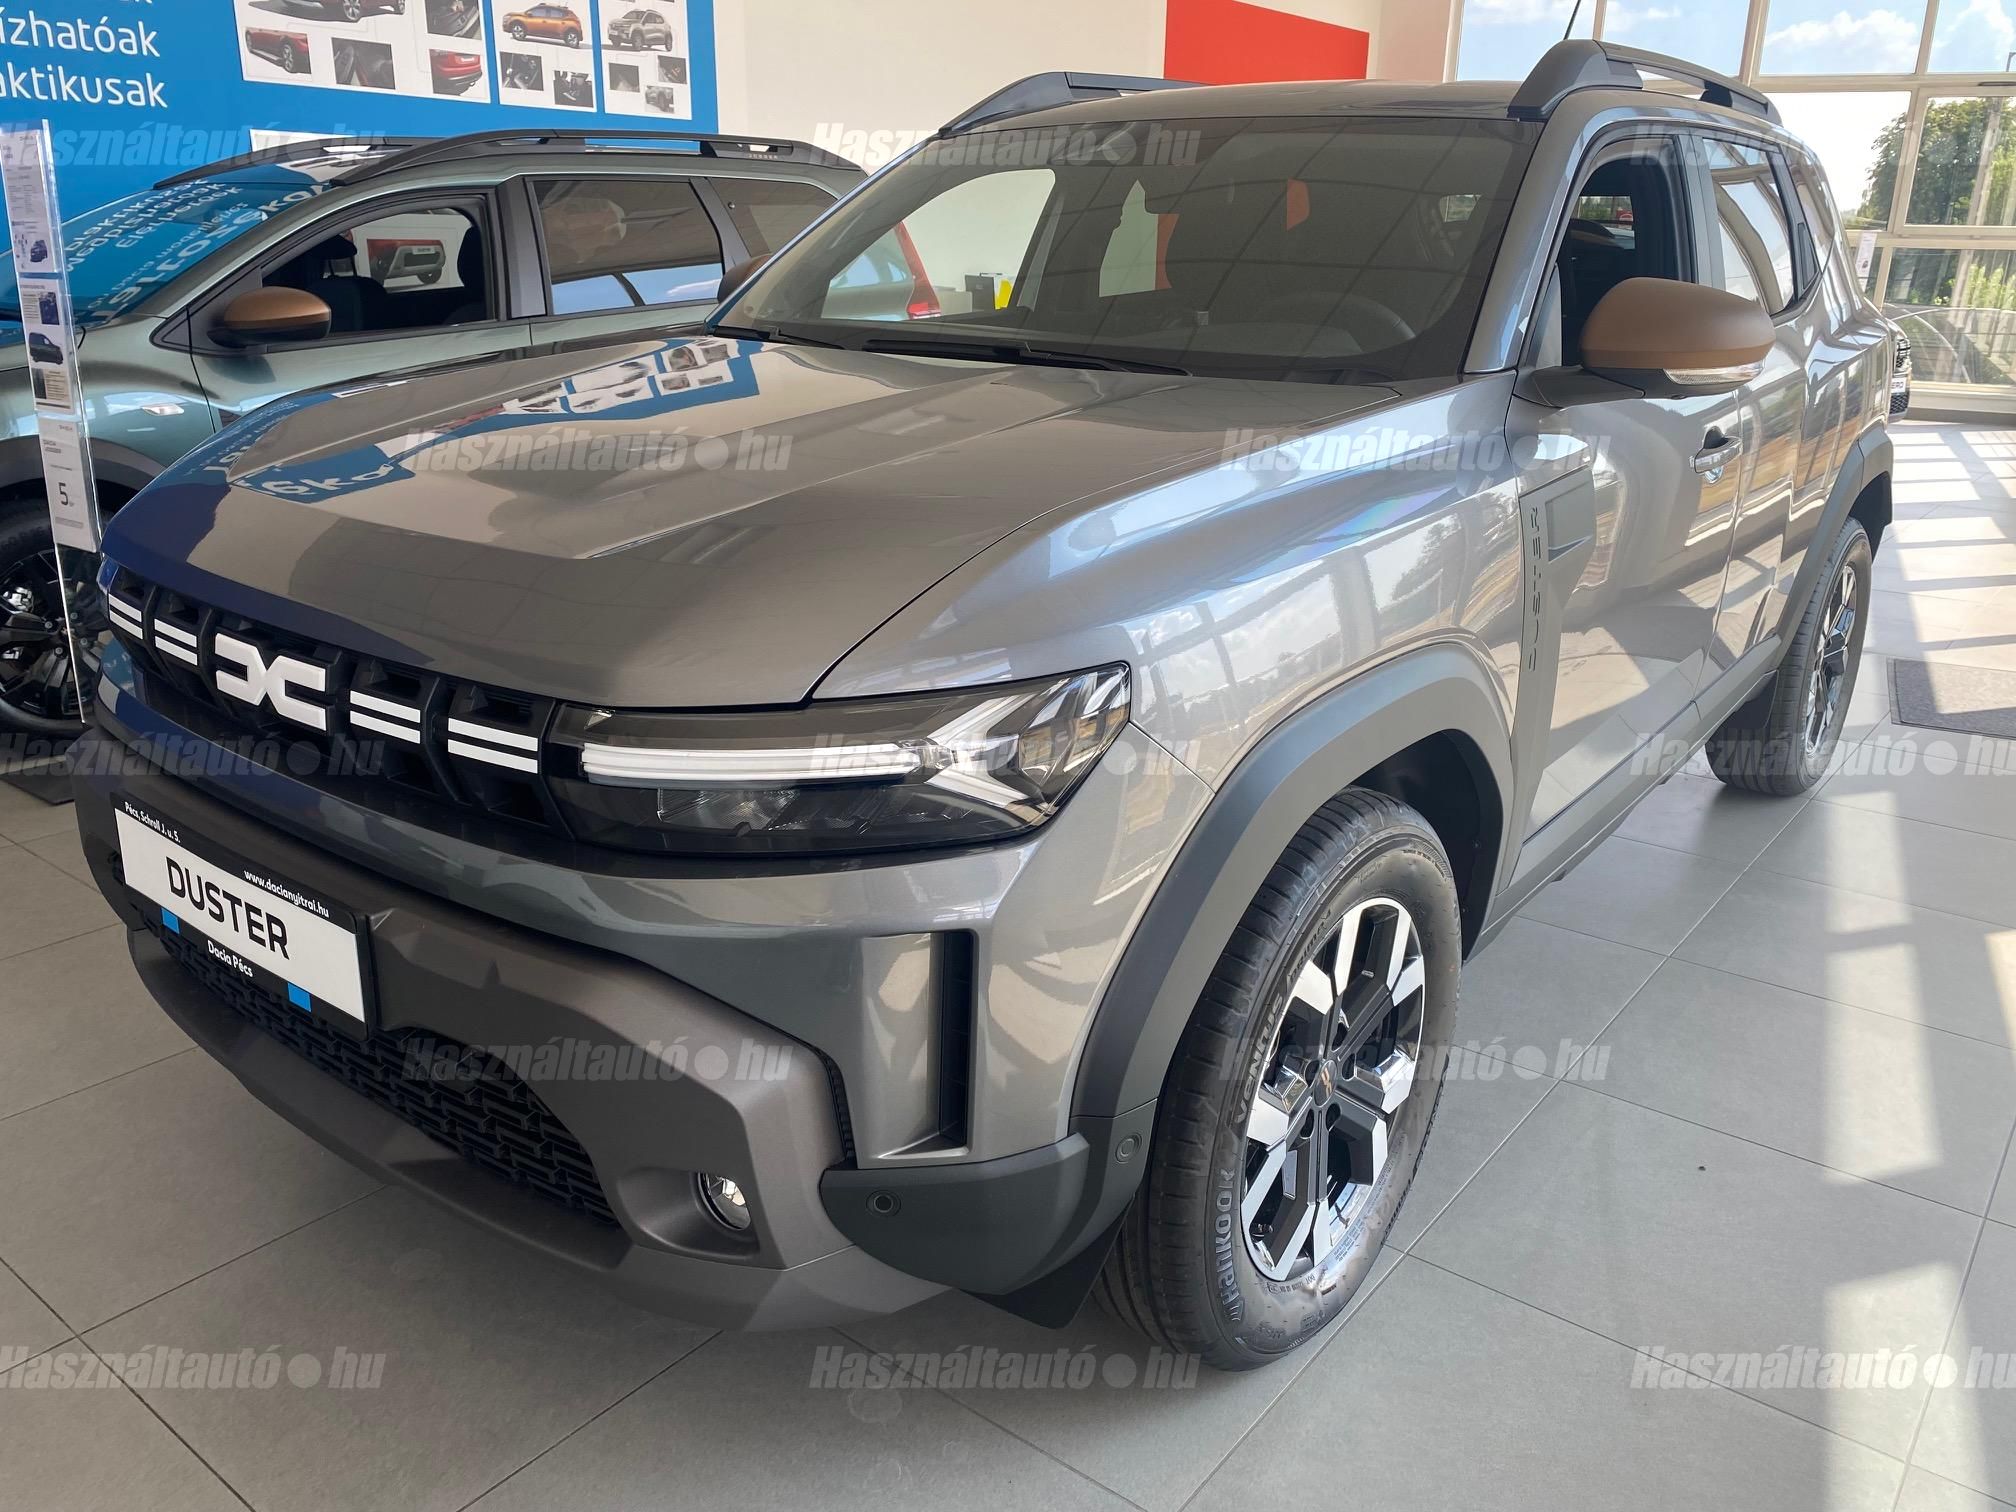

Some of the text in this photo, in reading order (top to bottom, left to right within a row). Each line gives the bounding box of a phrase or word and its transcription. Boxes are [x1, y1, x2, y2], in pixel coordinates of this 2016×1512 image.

[166, 856, 290, 960] DUSTER
[244, 870, 330, 918] www.dacianyitrai.hu
[207, 940, 253, 977] Dacia Pécs
